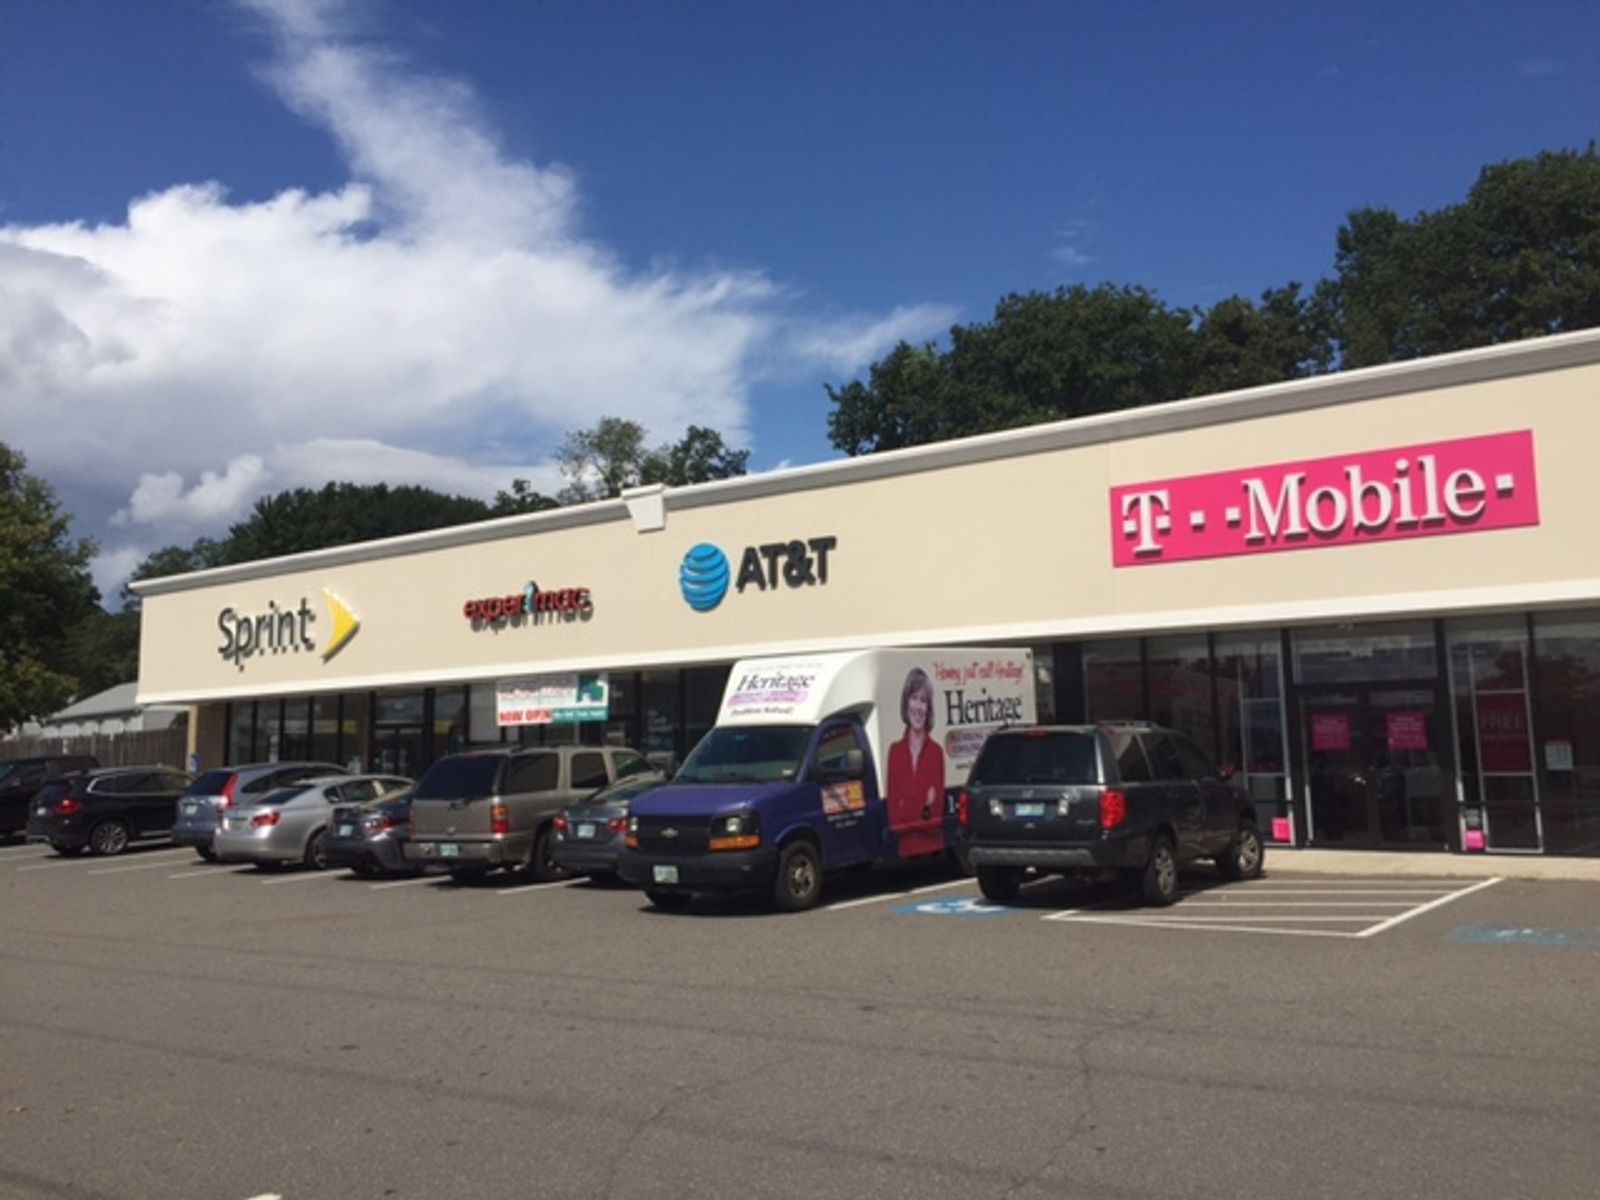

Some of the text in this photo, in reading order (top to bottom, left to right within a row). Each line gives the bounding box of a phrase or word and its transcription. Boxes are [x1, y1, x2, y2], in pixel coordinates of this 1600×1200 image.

[735, 534, 838, 594] AT&T
[217, 597, 316, 669] Sprint
[737, 671, 815, 692] Heritage
[944, 687, 1022, 727] Heritage
